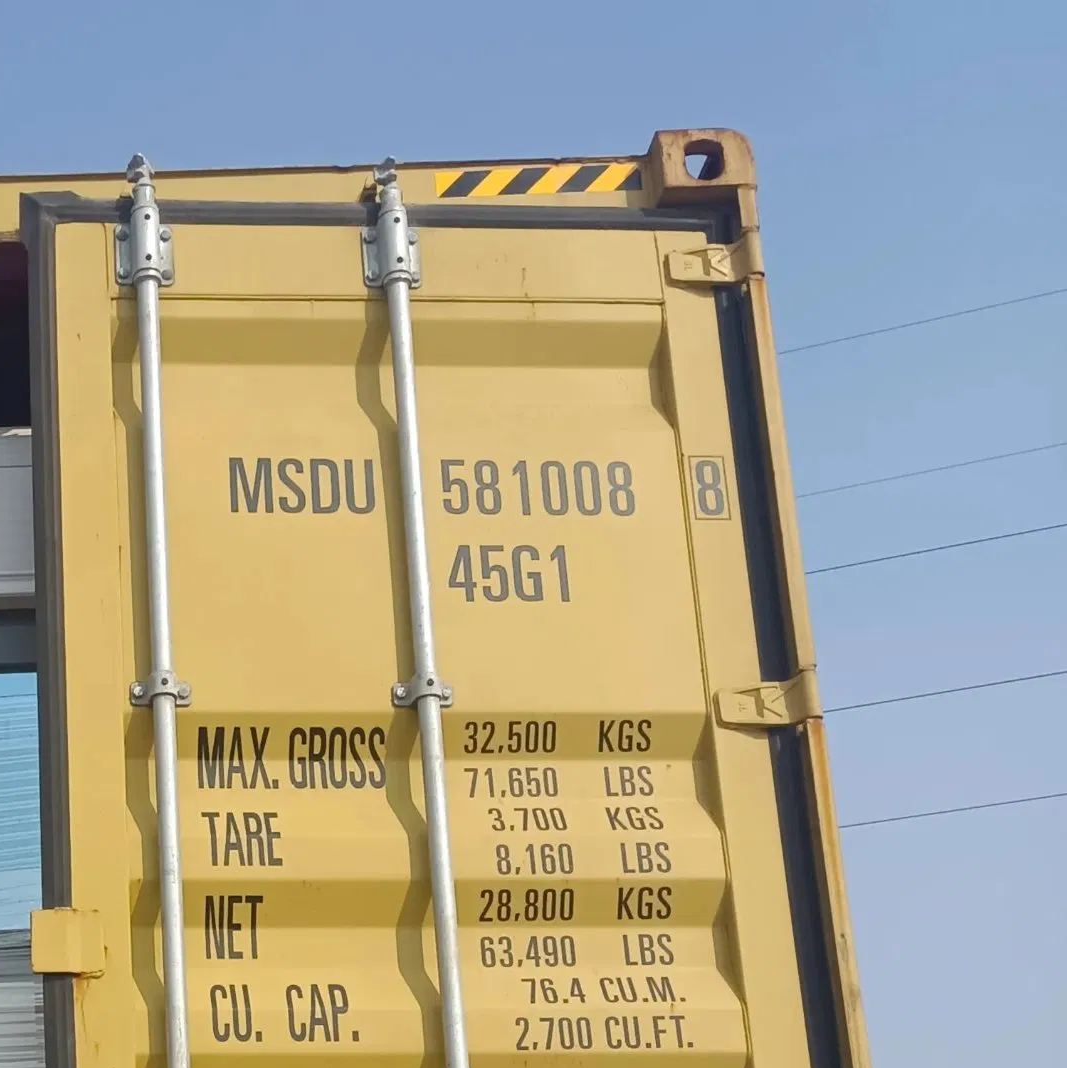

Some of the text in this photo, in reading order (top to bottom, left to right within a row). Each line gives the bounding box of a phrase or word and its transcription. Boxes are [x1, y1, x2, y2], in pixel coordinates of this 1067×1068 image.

[229, 457, 724, 518] MSDU 581008 8
[448, 545, 572, 603] 45G1
[598, 719, 652, 753] KGS
[197, 726, 387, 791] MAX. GROSS
[603, 765, 654, 797] LBS
[605, 806, 664, 831] KGS
[201, 811, 284, 868] TARE
[620, 842, 672, 874] LBS
[617, 886, 672, 920] KGS
[204, 895, 264, 960] NET
[622, 933, 674, 966] LBS
[520, 976, 686, 1004] 76.4 CU.M.
[210, 984, 361, 1043] CU. CAP.
[604, 1015, 694, 1049] CU.FT.
